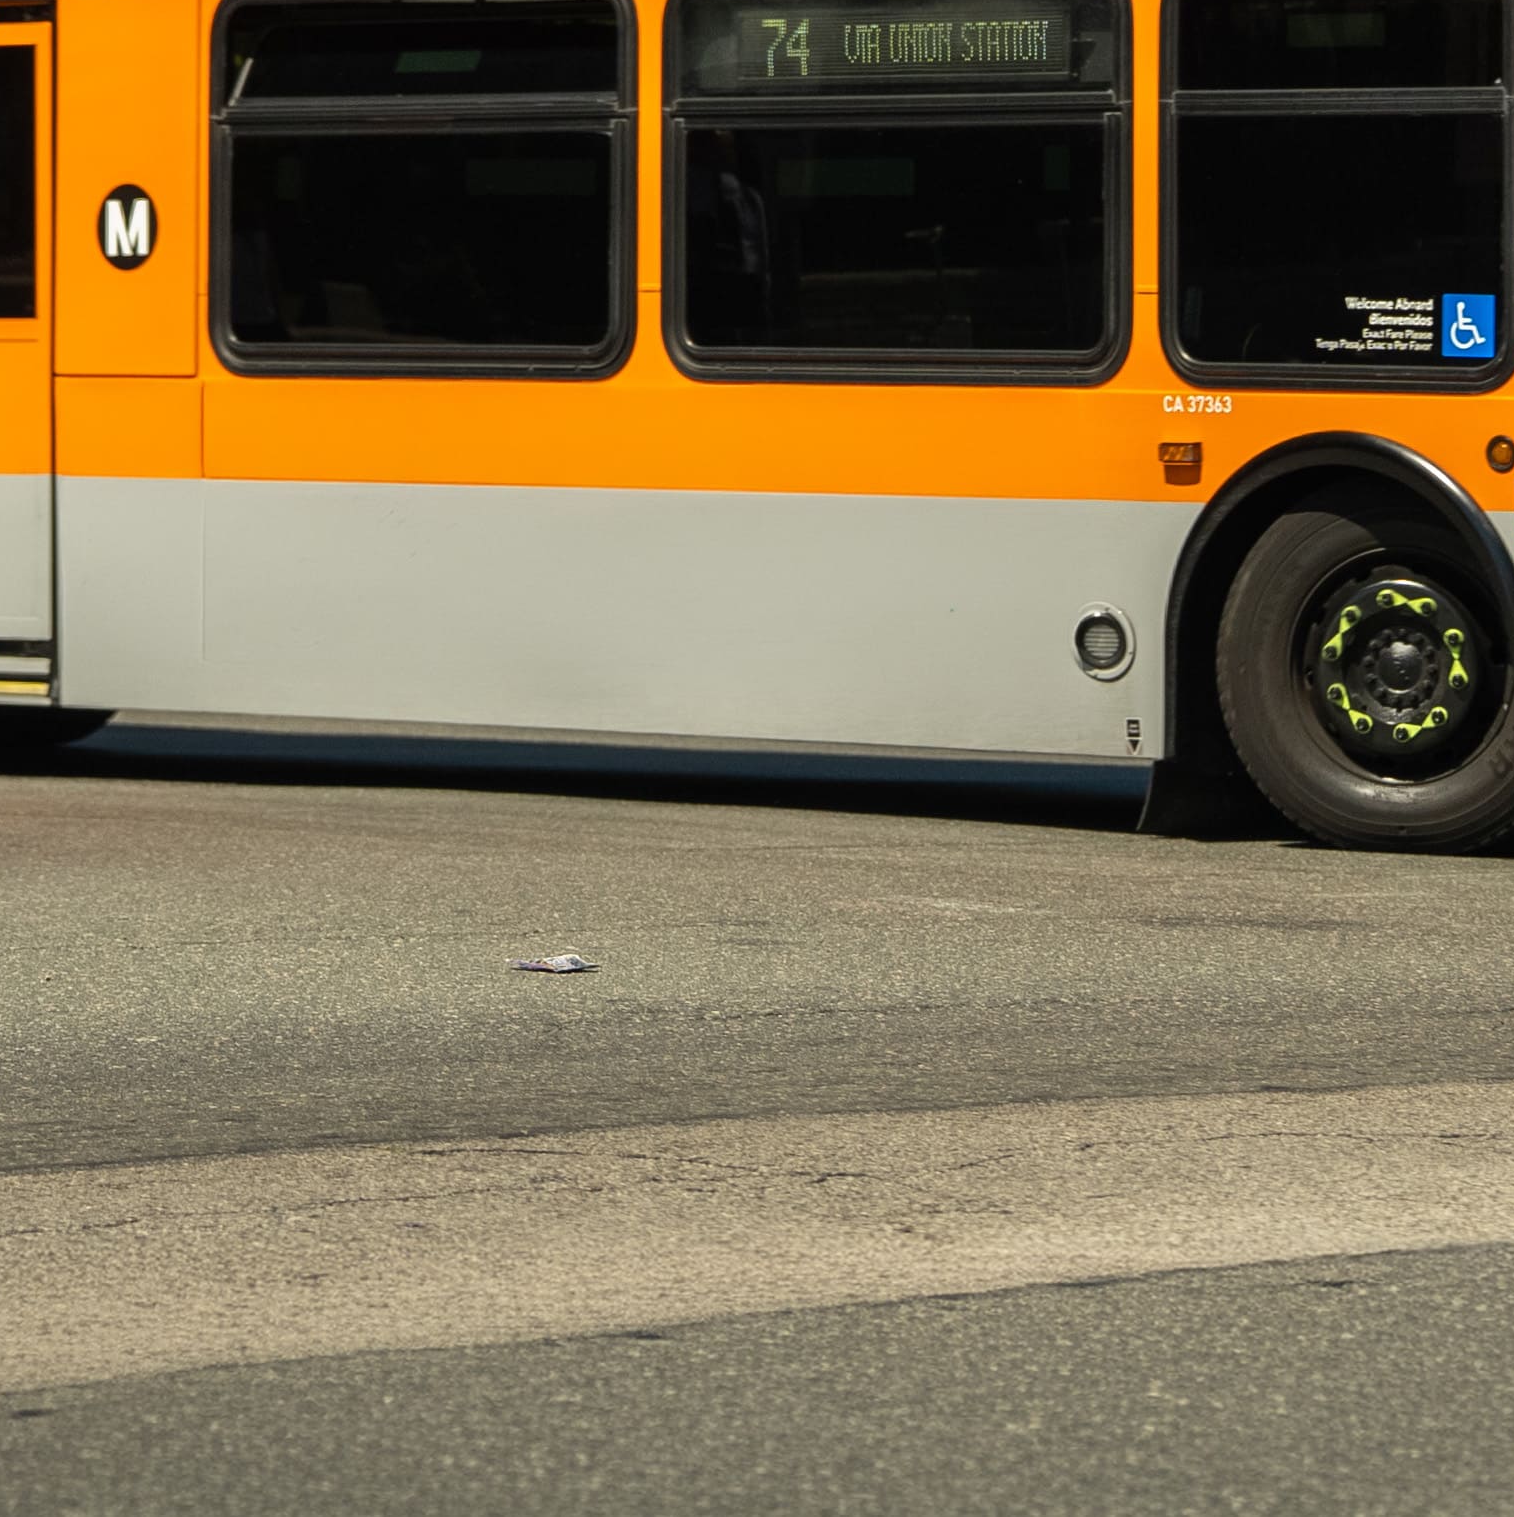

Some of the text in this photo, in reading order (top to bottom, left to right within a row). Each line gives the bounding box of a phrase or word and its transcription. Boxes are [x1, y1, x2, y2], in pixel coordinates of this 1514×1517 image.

[761, 18, 1049, 77] 74 VIA UNION STATION
[105, 197, 149, 257] M
[1345, 296, 1394, 310] Welcome
[1163, 395, 1232, 413] CA 37363
